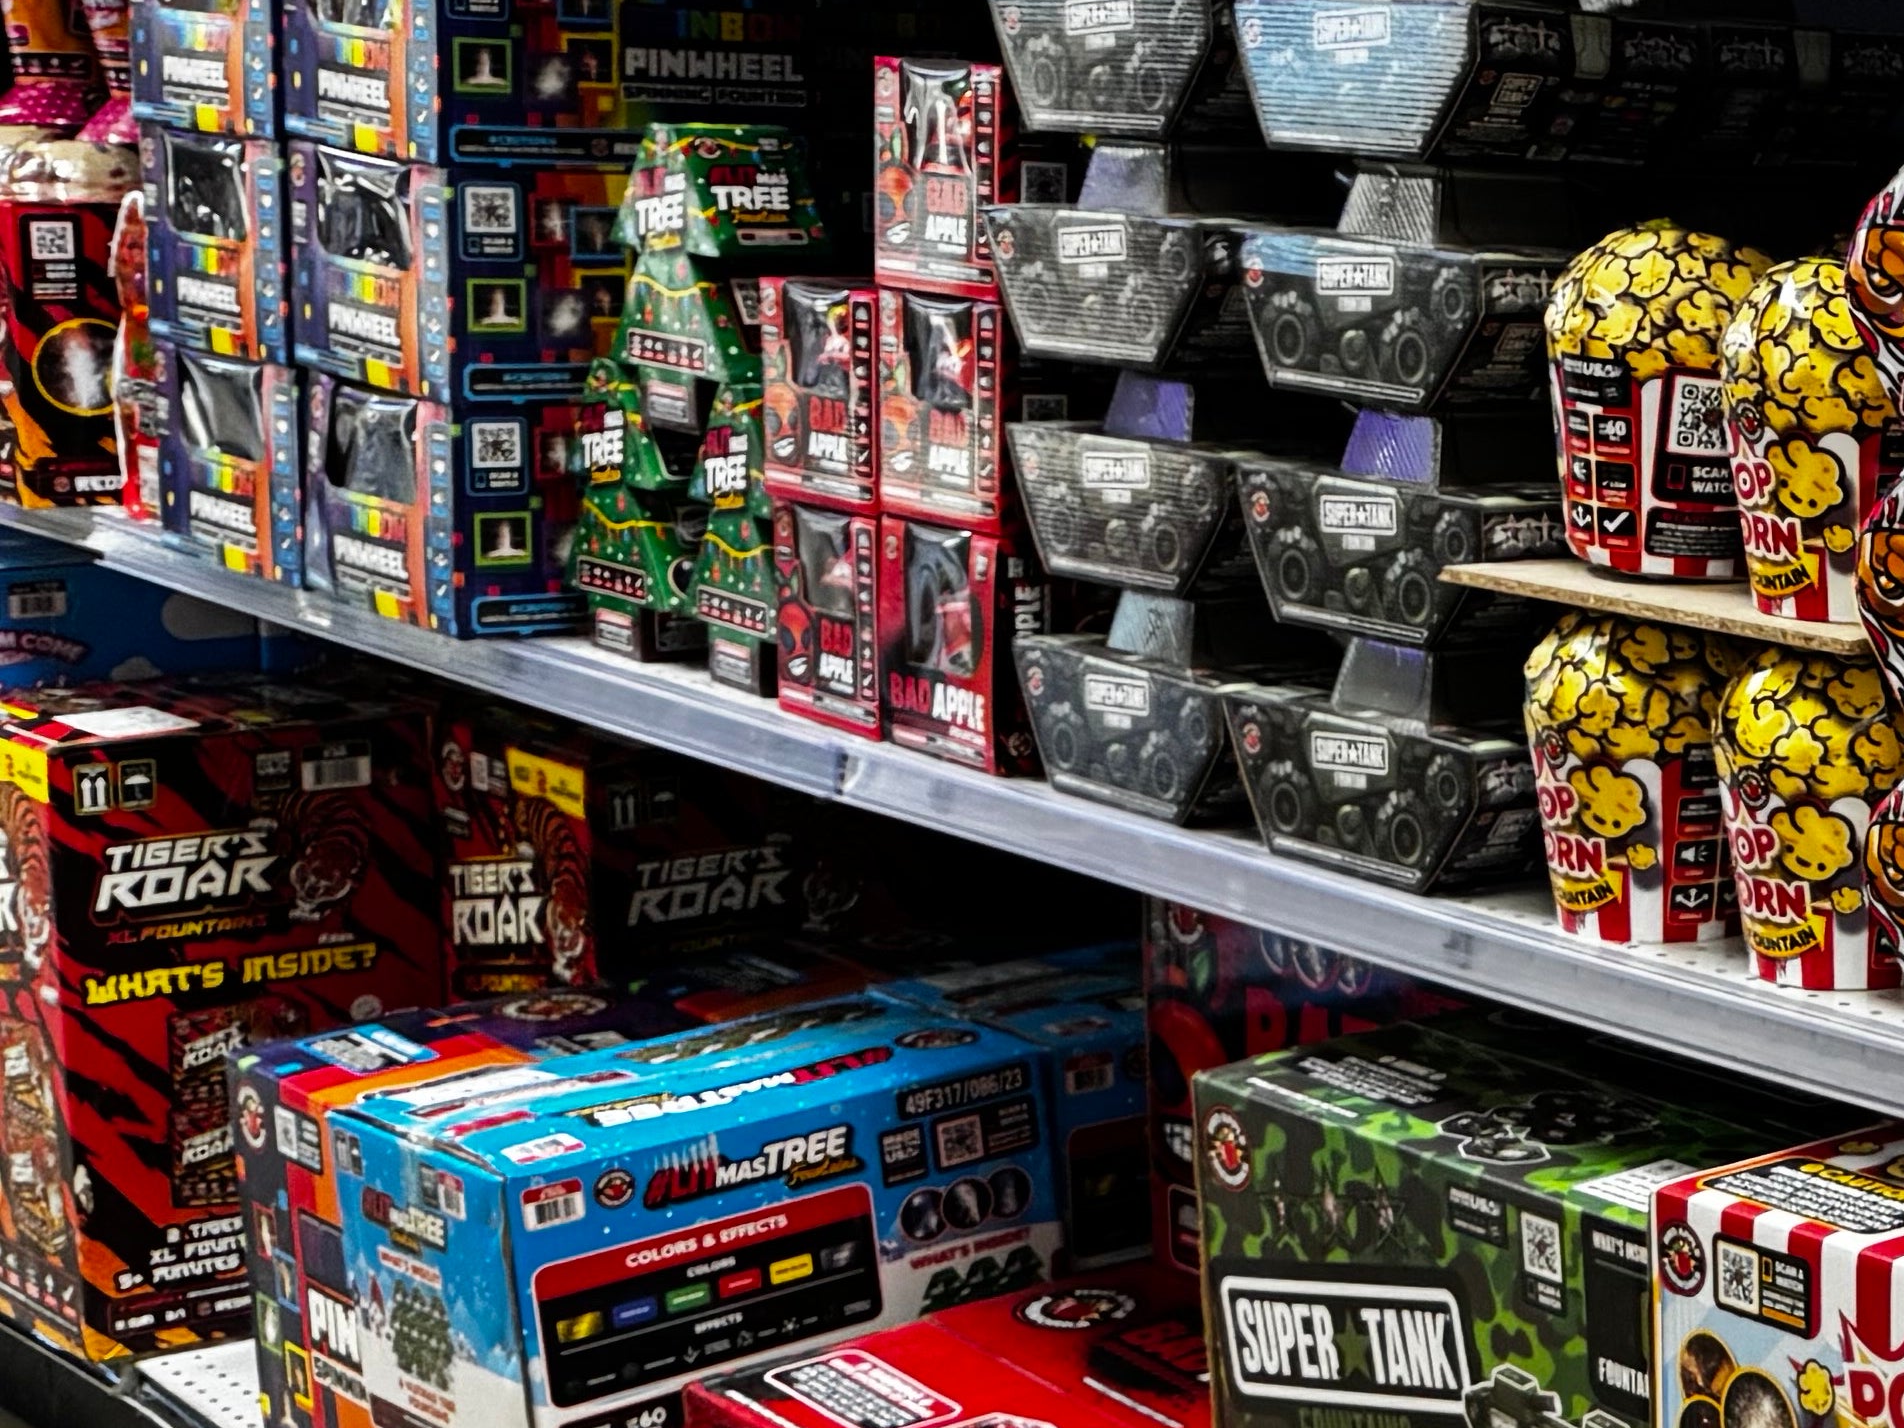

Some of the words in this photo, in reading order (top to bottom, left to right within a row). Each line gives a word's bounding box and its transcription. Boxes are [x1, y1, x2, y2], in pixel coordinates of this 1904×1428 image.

[625, 48, 802, 81] PINWHEEL
[714, 184, 790, 212] TREE
[890, 674, 931, 709] BAD
[933, 680, 985, 727] APPLE
[105, 828, 271, 868] TIGER'S
[95, 865, 281, 912] ROAR
[450, 861, 536, 900] TIGER'S
[452, 900, 546, 946] ROAR
[84, 960, 225, 1006] WHAT'S
[243, 944, 378, 982] INSIDE?
[626, 1241, 698, 1268] COLORS
[703, 1232, 717, 1249] &
[719, 1214, 788, 1243] EFFECTS
[1235, 1298, 1340, 1381] SUPER
[1360, 1308, 1457, 1390] TANK
